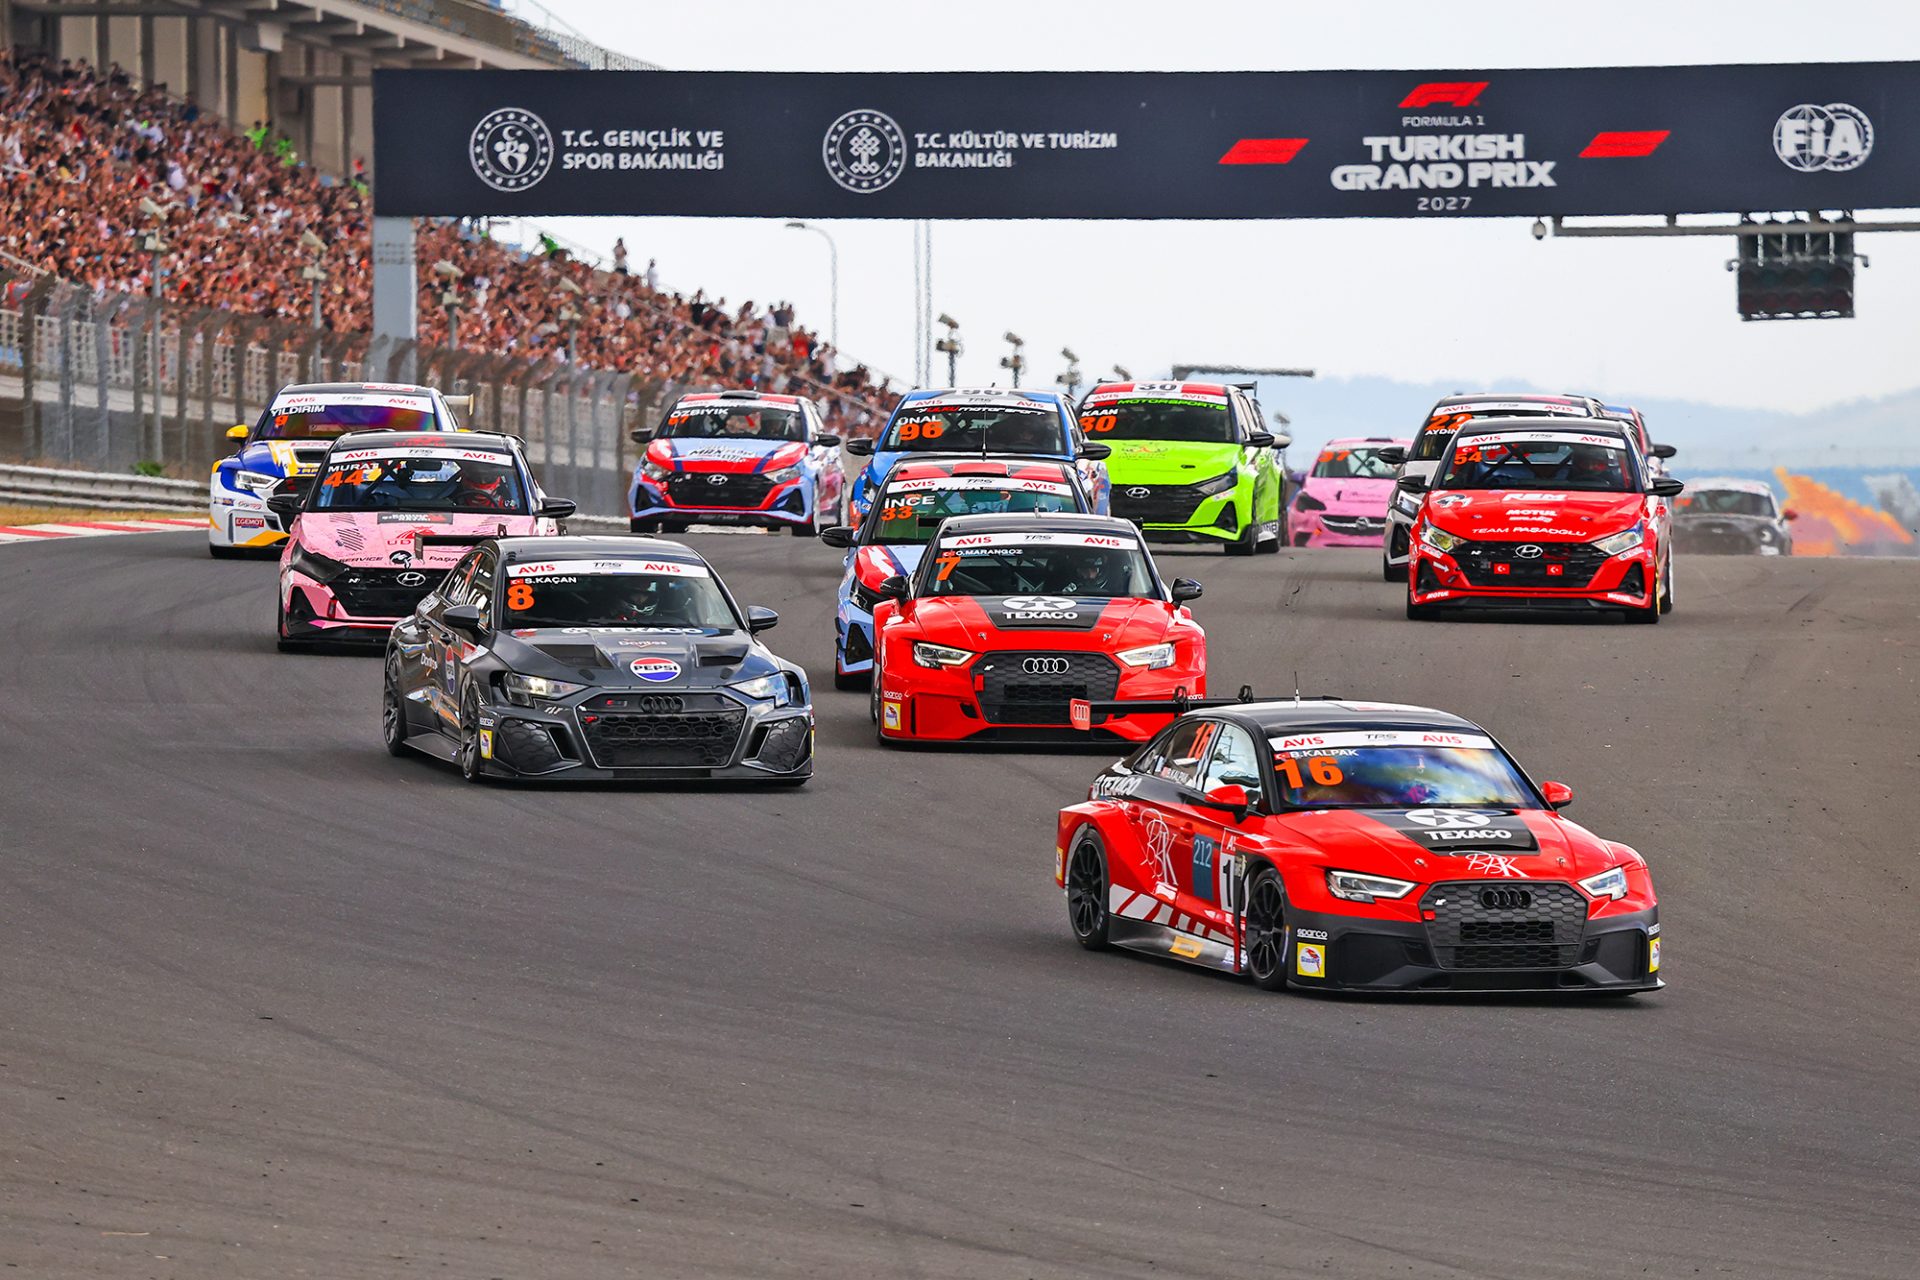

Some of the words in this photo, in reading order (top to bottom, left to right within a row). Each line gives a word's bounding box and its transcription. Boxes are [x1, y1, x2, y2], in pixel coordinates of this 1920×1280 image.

[1402, 116, 1473, 127] FORMULA
[1476, 115, 1486, 126] 1
[561, 130, 600, 147] T.C.
[603, 128, 692, 151] GENÇLİK
[696, 131, 725, 148] VE
[914, 133, 946, 148] T.C.
[949, 130, 1018, 149] KÜLTÜR
[1021, 133, 1045, 148] VE
[1048, 130, 1118, 149] TURİZM
[1363, 134, 1525, 161] TURKISH
[562, 153, 615, 169] SPOR
[618, 150, 725, 170] BAKANLIĞI
[915, 150, 1013, 168] BAKANLIĞI
[1330, 163, 1465, 190] GRAND
[1467, 160, 1558, 188] PRIX
[1416, 196, 1472, 211] 2027
[287, 396, 317, 404] AVIS
[388, 398, 417, 406] AVIS
[1016, 400, 1046, 408] AVIS
[269, 404, 326, 417] YILDIRIM
[1081, 409, 1119, 417] KAAN
[1443, 404, 1472, 412] AVIS
[1544, 404, 1574, 412] AVIS
[899, 421, 945, 441] 96
[1470, 436, 1502, 444] AVIS
[1580, 436, 1611, 445] AVIS
[344, 451, 378, 459] AVIS
[463, 452, 496, 461] AVIS
[1453, 451, 1483, 465] 54
[328, 463, 380, 473] MURAT
[323, 470, 366, 489] 44
[901, 480, 936, 489] AVIS
[1022, 482, 1057, 491] AVIS
[881, 506, 913, 521] 33
[1472, 527, 1509, 535] TEAM
[956, 537, 992, 546] AVIS
[1084, 537, 1120, 547] AVIS
[955, 548, 1023, 557] O.MARANGOZ
[518, 564, 556, 575] AVIS
[644, 563, 681, 573] AVIS
[936, 556, 962, 581] 7
[524, 576, 577, 586] S.KAÇAN
[507, 584, 535, 611] 8
[1002, 611, 1078, 620] TEXACO
[1283, 736, 1325, 749] AVIS
[1422, 734, 1463, 745] AVIS
[1290, 749, 1360, 759] B.KALPAK
[1274, 756, 1344, 790] 16
[1424, 829, 1513, 841] TEXACO
[1193, 838, 1212, 868] 212
[1297, 928, 1328, 940] sparco
